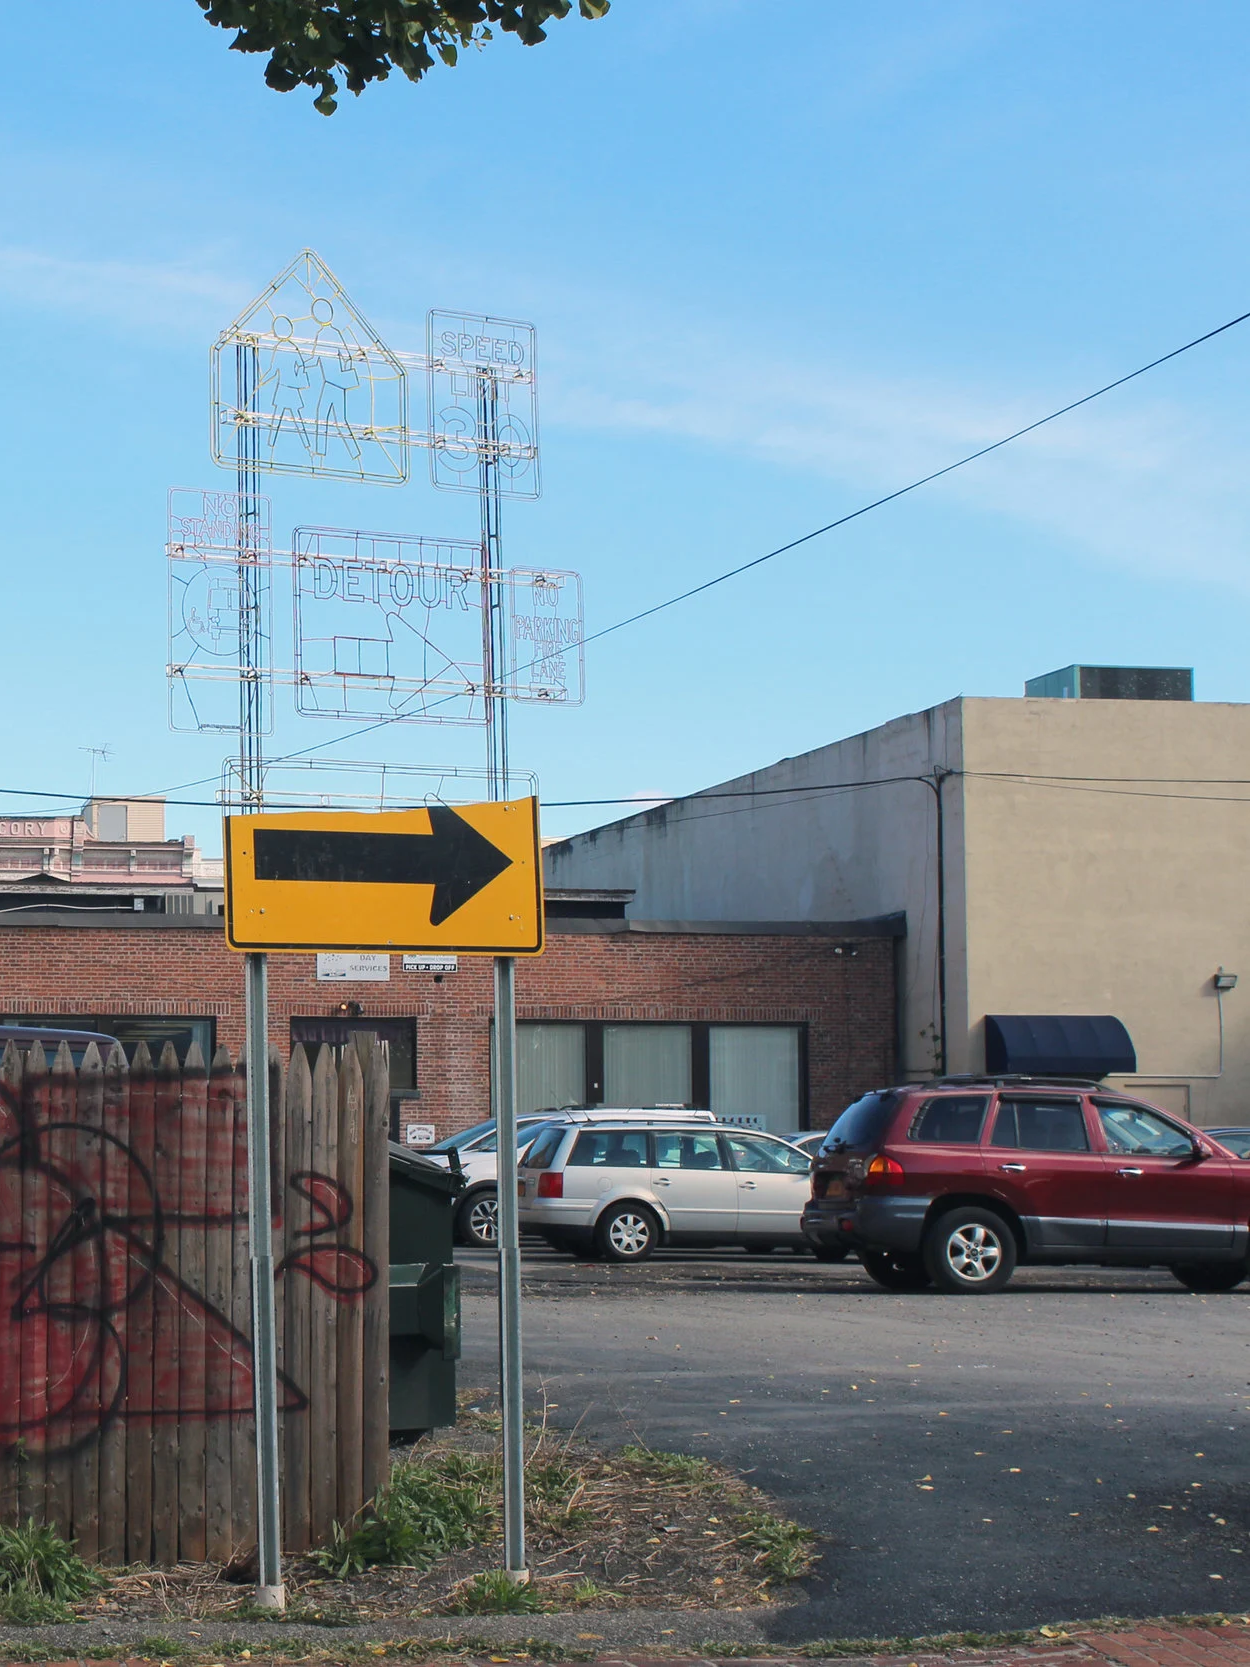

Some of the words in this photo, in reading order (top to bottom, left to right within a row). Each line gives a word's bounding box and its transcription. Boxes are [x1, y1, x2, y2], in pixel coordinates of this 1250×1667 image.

[440, 331, 525, 365] SPEED
[450, 371, 511, 402] LIMIT
[438, 406, 531, 479] 30
[203, 496, 238, 518] NO
[181, 517, 260, 542] STANDING
[314, 557, 469, 611] DETOUR
[533, 582, 558, 607] NO
[515, 615, 581, 643] PARKING
[534, 640, 563, 659] FIRE
[531, 660, 566, 679] LANE
[350, 964, 388, 972] SERVICES
